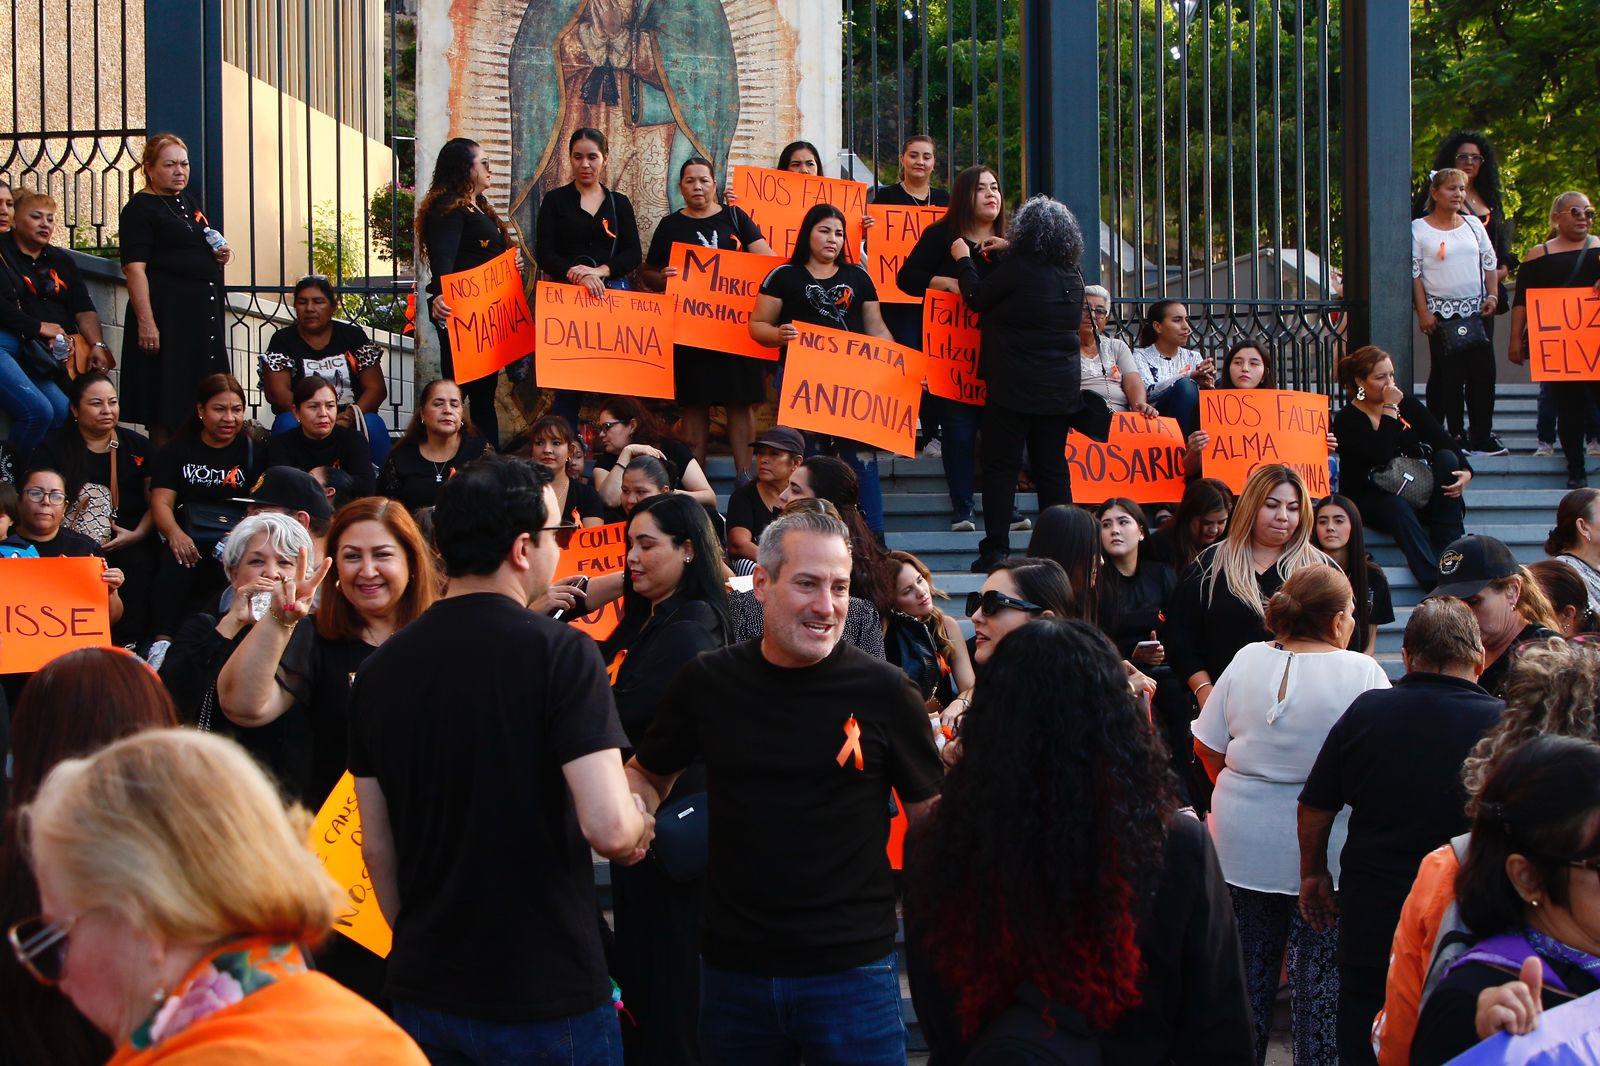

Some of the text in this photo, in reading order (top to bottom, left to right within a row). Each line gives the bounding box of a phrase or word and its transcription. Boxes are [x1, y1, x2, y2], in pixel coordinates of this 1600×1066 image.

[745, 170, 791, 206] NOS
[450, 259, 513, 300] NOS FALTA
[545, 286, 564, 304] EN
[631, 298, 662, 316] FALTA
[1536, 297, 1600, 332] LUZ
[453, 296, 530, 354] MARTINA
[544, 317, 662, 356] DALLANA
[307, 357, 344, 371] CHIC
[800, 331, 906, 376] NOS FALTA
[1540, 340, 1600, 373] ELV
[790, 379, 913, 439] ANTONIA
[1207, 394, 1329, 440] NOS FALTA
[1065, 443, 1185, 484] ROSARIO
[1212, 432, 1279, 461] ALMA
[579, 527, 625, 548] CULI
[0, 604, 103, 637] ISSE
